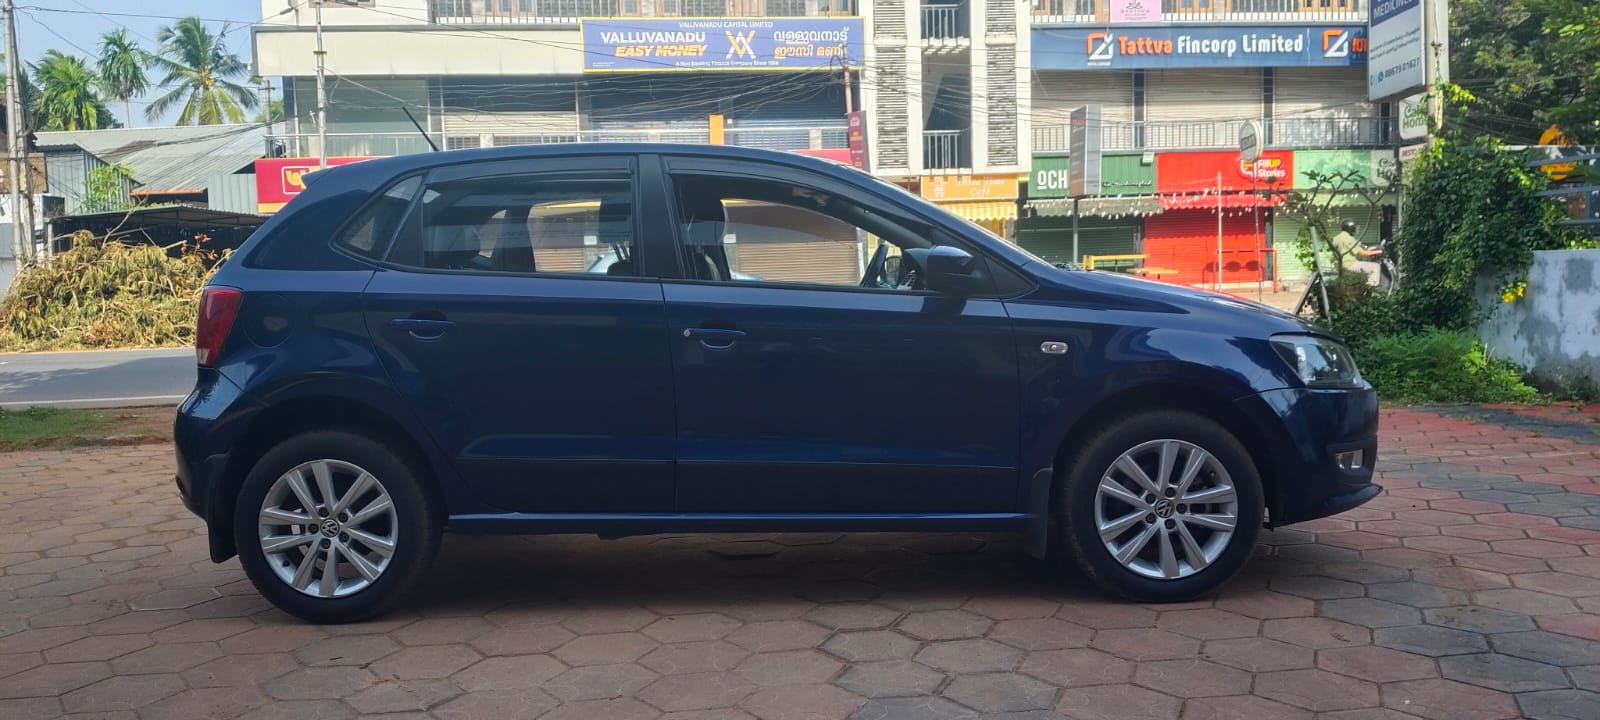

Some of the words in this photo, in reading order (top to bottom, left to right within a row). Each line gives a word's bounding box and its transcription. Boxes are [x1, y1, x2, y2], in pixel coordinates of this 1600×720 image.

[678, 20, 722, 29] VALLUVANADU
[601, 31, 706, 43] VALLUVANADU
[615, 45, 654, 57] EASY
[655, 44, 708, 57] MONEY
[1117, 36, 1173, 55] Tattva
[1177, 35, 1237, 58] Fincorp
[1242, 34, 1303, 53] Limited
